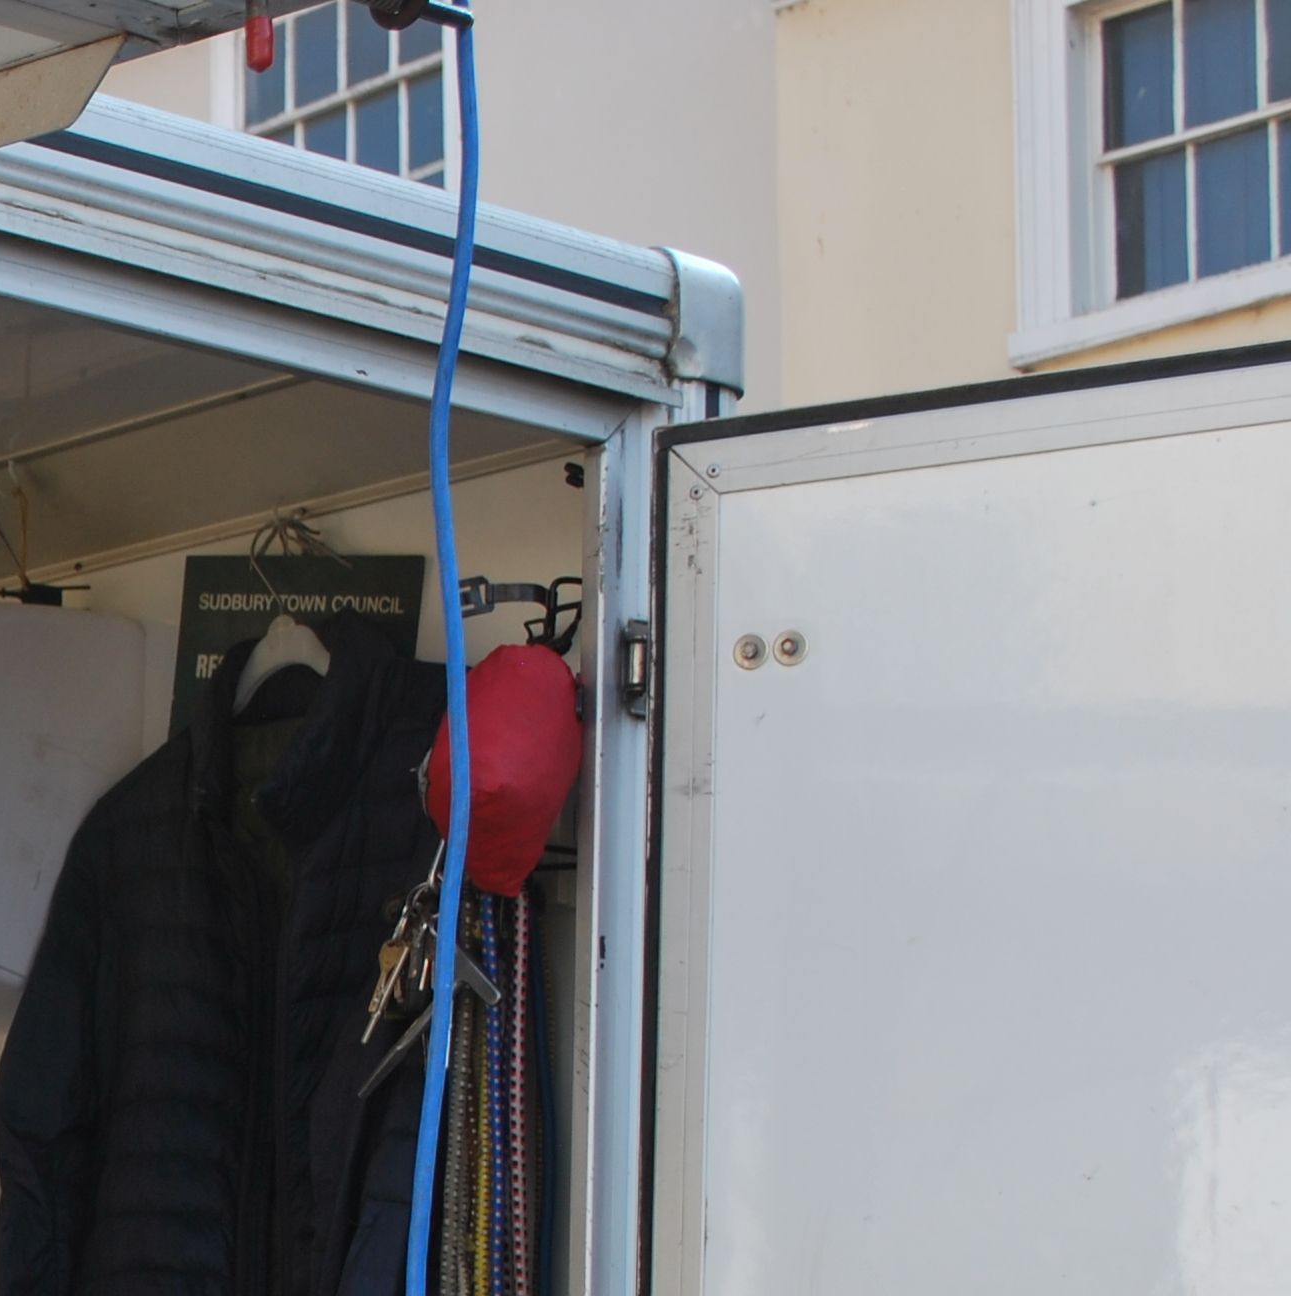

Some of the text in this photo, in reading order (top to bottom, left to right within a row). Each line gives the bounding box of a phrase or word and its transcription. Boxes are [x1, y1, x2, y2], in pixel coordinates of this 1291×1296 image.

[198, 593, 404, 615] SUDBURY TOWN COUNCIL
